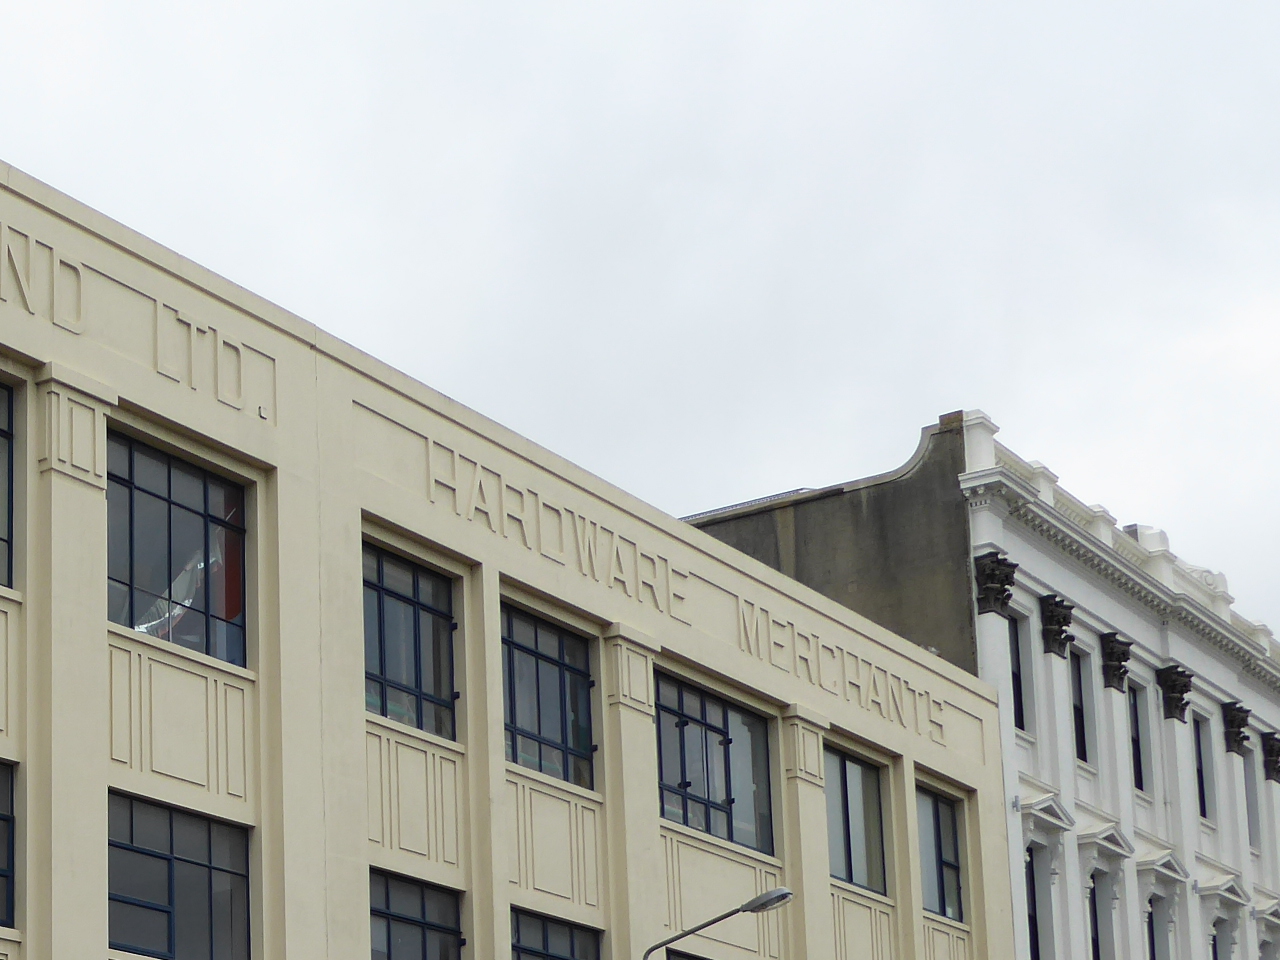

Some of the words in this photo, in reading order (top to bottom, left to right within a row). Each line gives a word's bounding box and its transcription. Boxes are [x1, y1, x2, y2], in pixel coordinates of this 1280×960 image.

[157, 300, 267, 420] LTD.
[427, 437, 692, 627] HARDWARE
[737, 599, 946, 746] MERCHANTS
